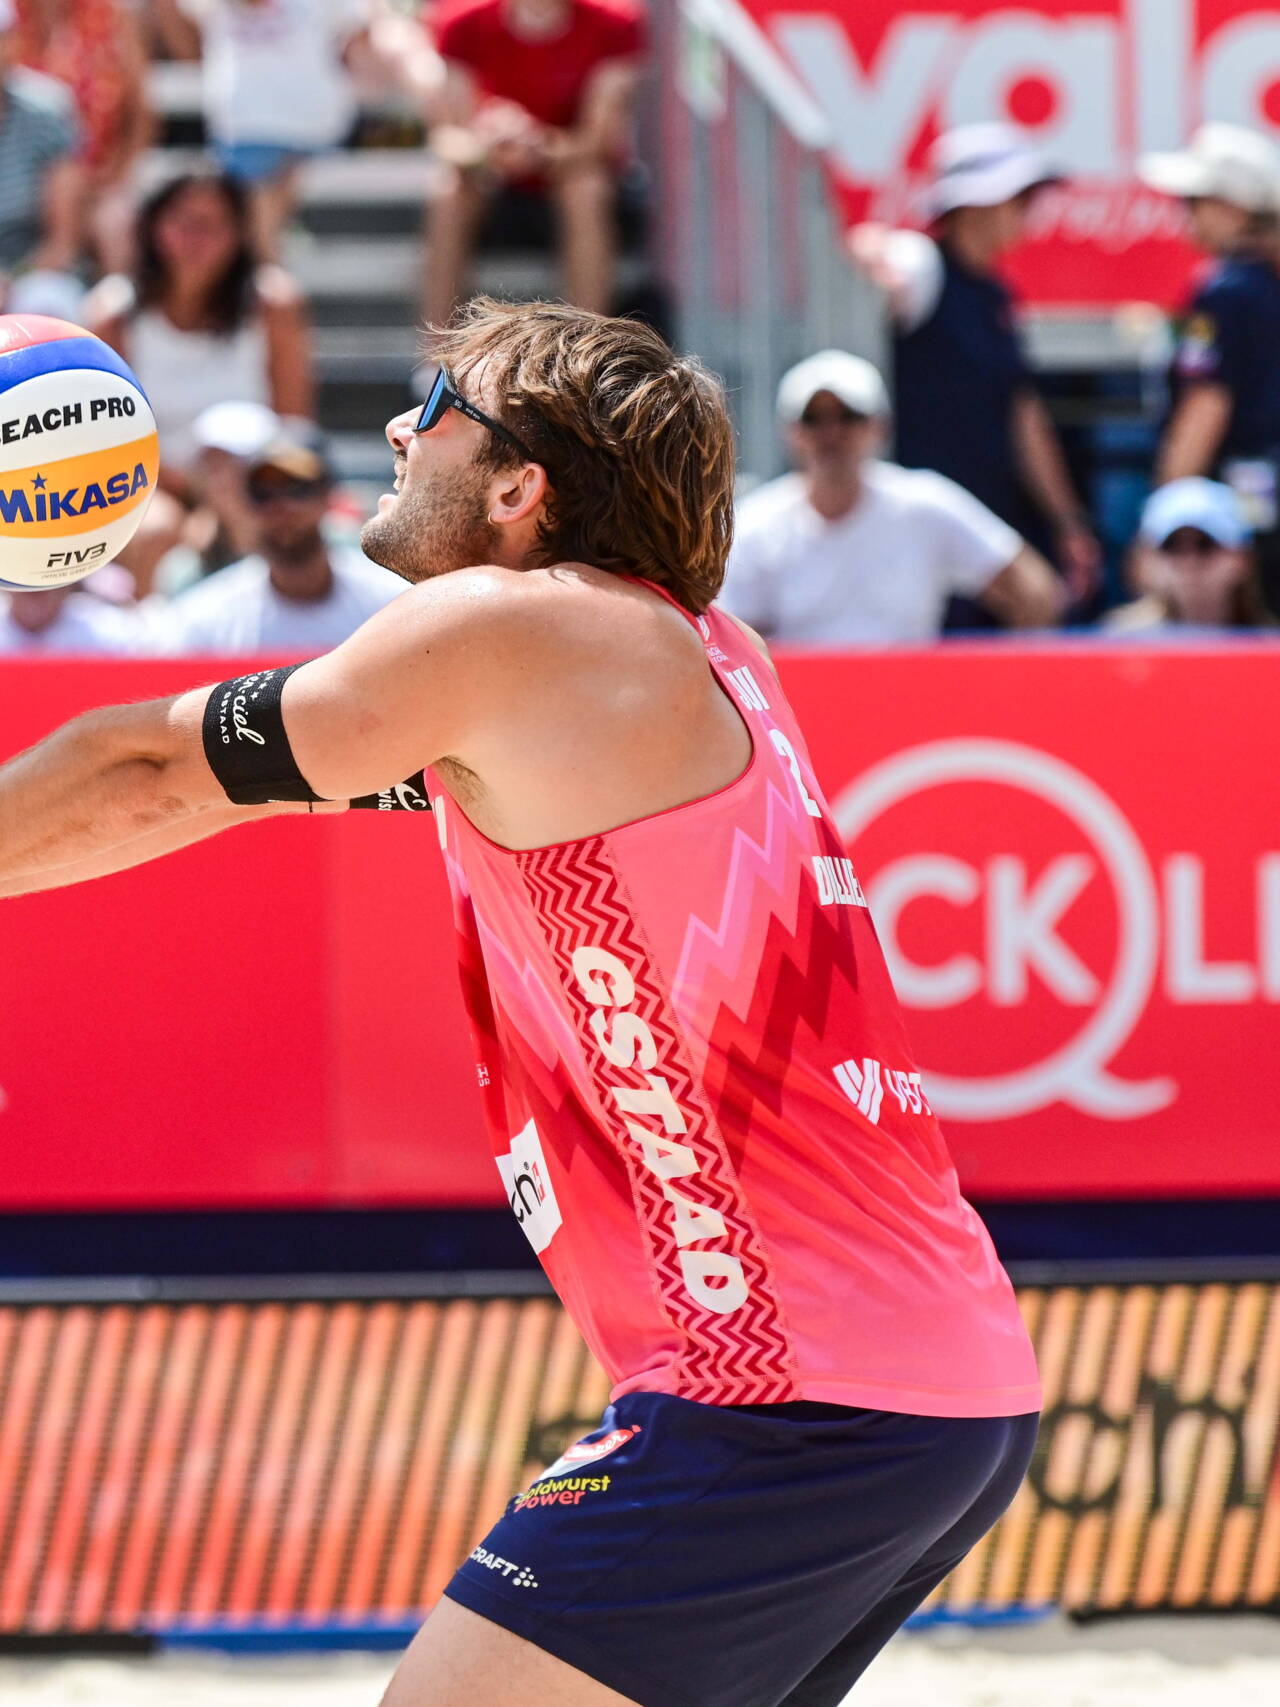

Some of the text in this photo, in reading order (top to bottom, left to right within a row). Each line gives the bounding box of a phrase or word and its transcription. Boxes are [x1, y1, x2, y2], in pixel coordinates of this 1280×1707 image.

[90, 396, 136, 421] PRO
[769, 728, 822, 818] 2
[571, 945, 749, 1315] GSTAAD
[470, 1545, 520, 1577] CRAFT
